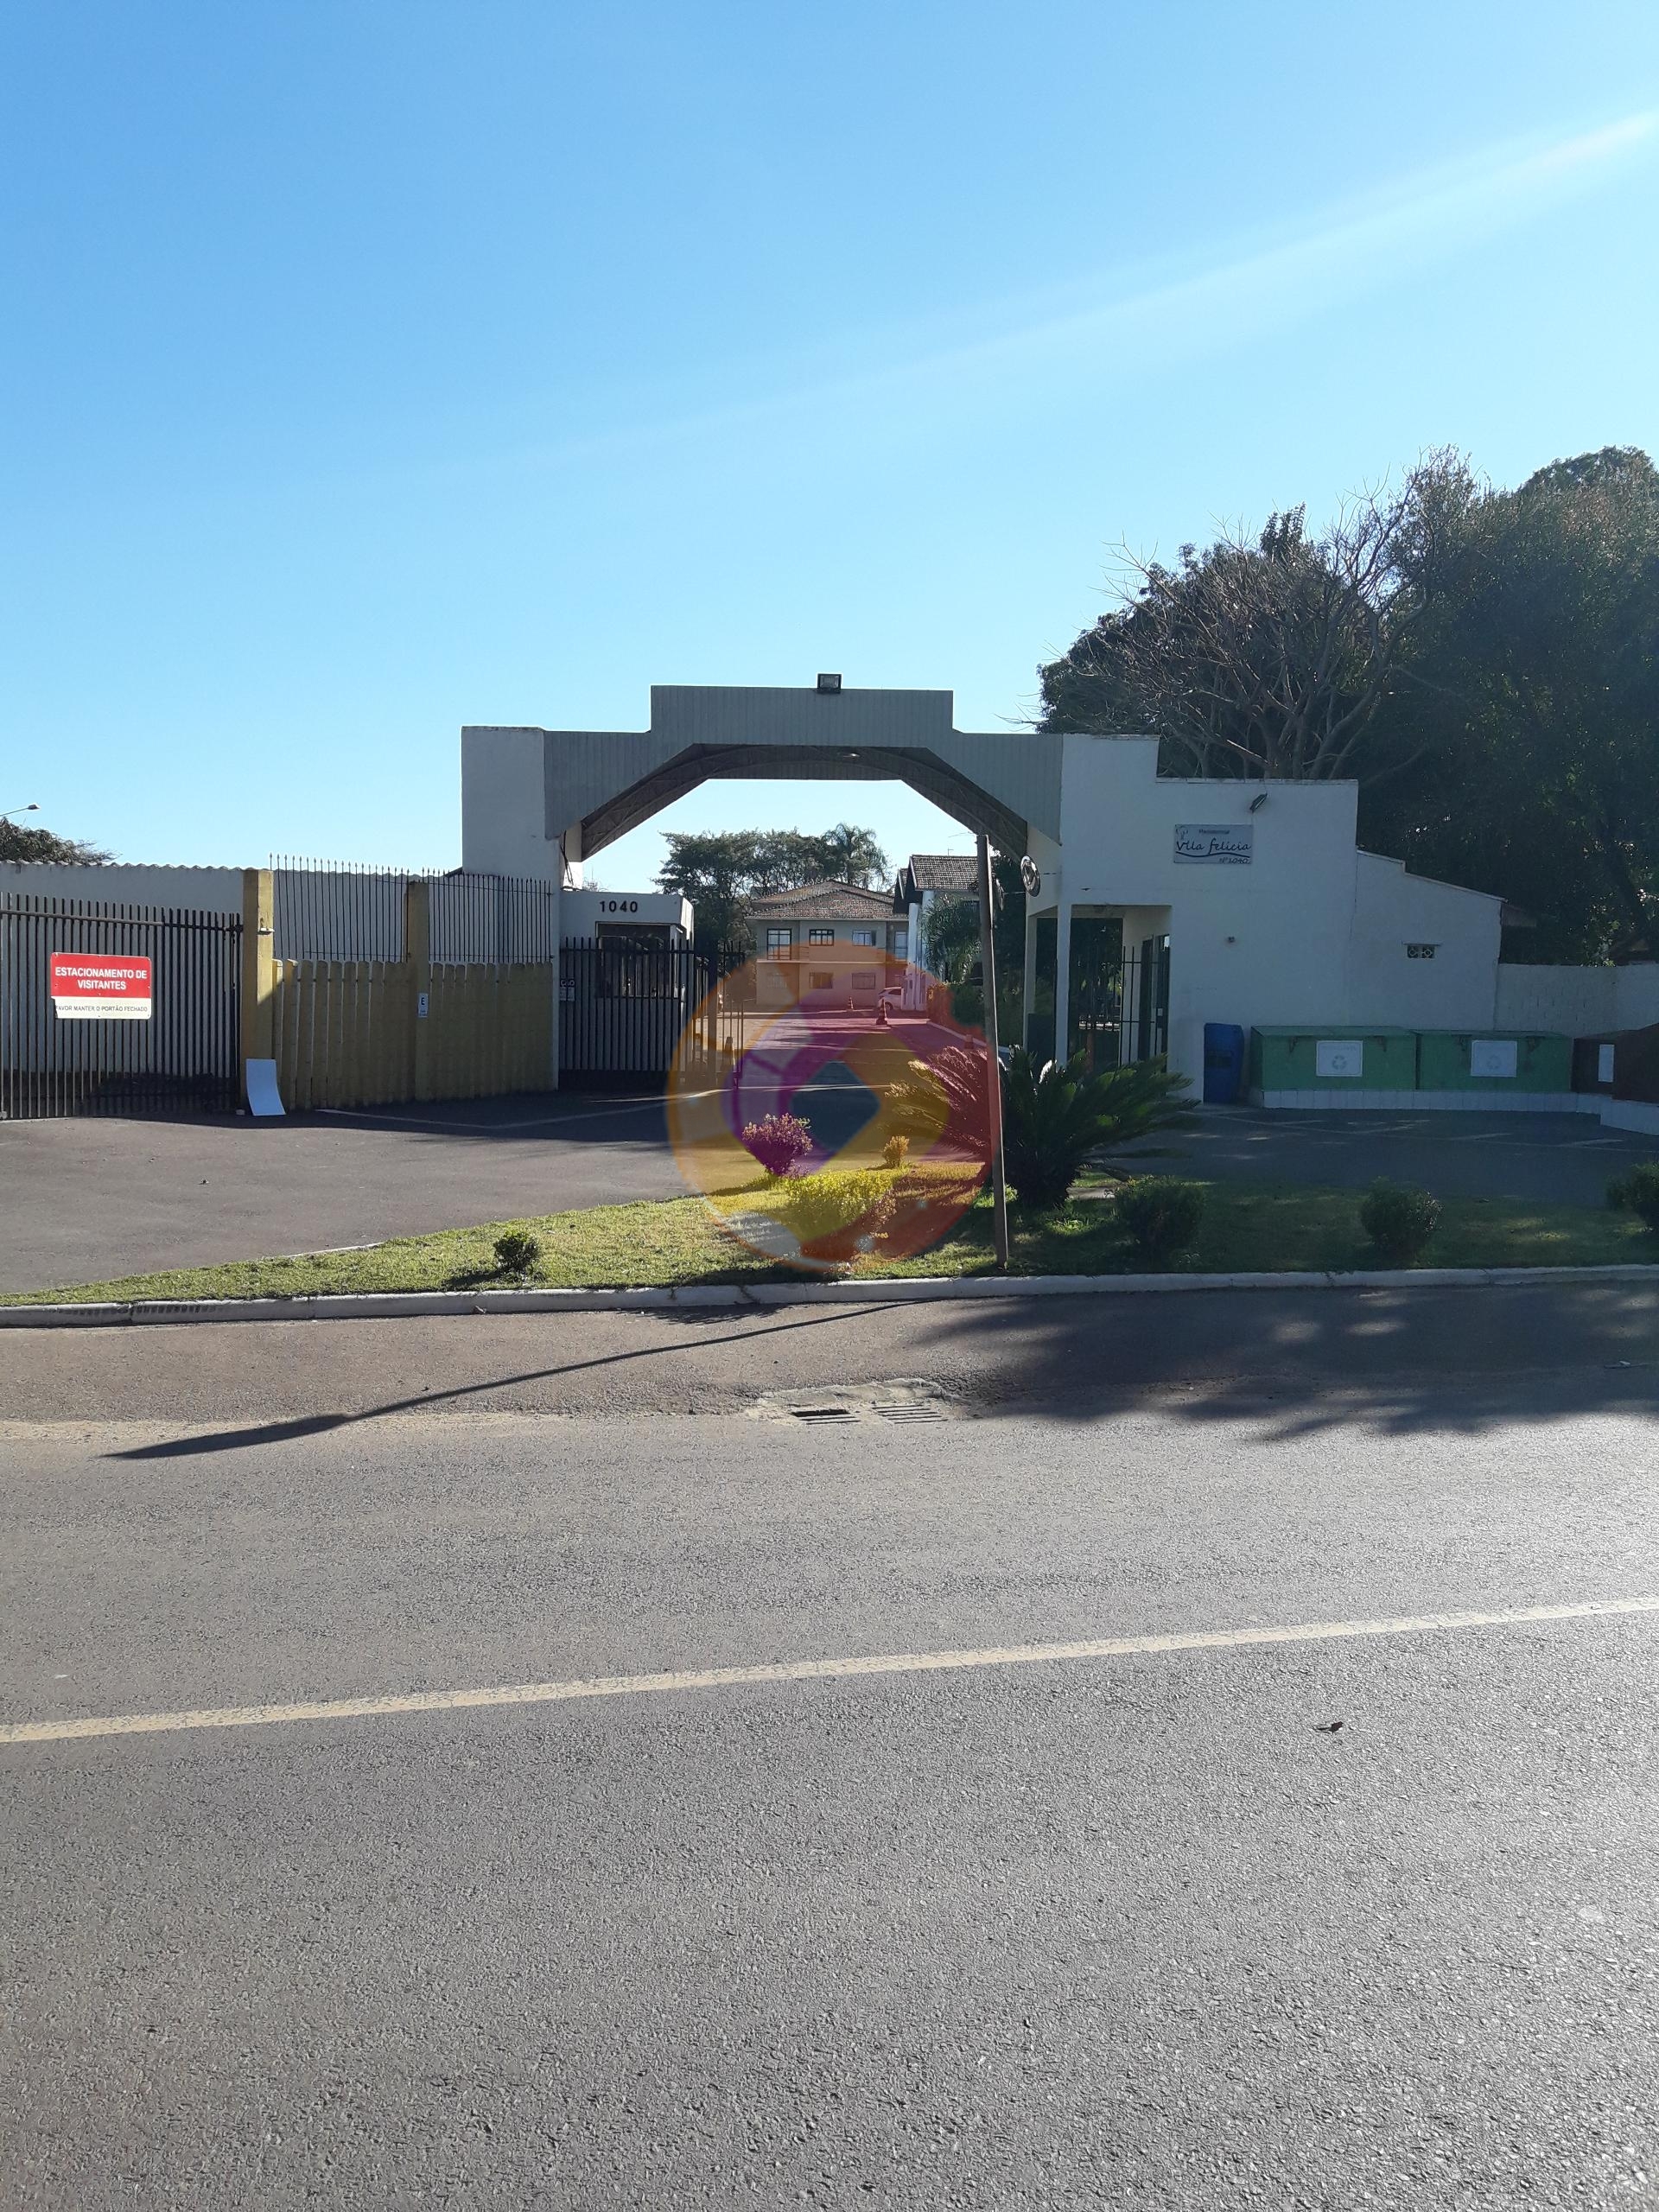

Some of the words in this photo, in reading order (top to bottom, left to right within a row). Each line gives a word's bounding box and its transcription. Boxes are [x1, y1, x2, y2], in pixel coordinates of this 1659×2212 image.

[600, 900, 638, 913] 1040
[55, 967, 134, 979] ESTACIONAMENTO
[136, 969, 148, 979] DE
[77, 979, 127, 990] VISITANTES
